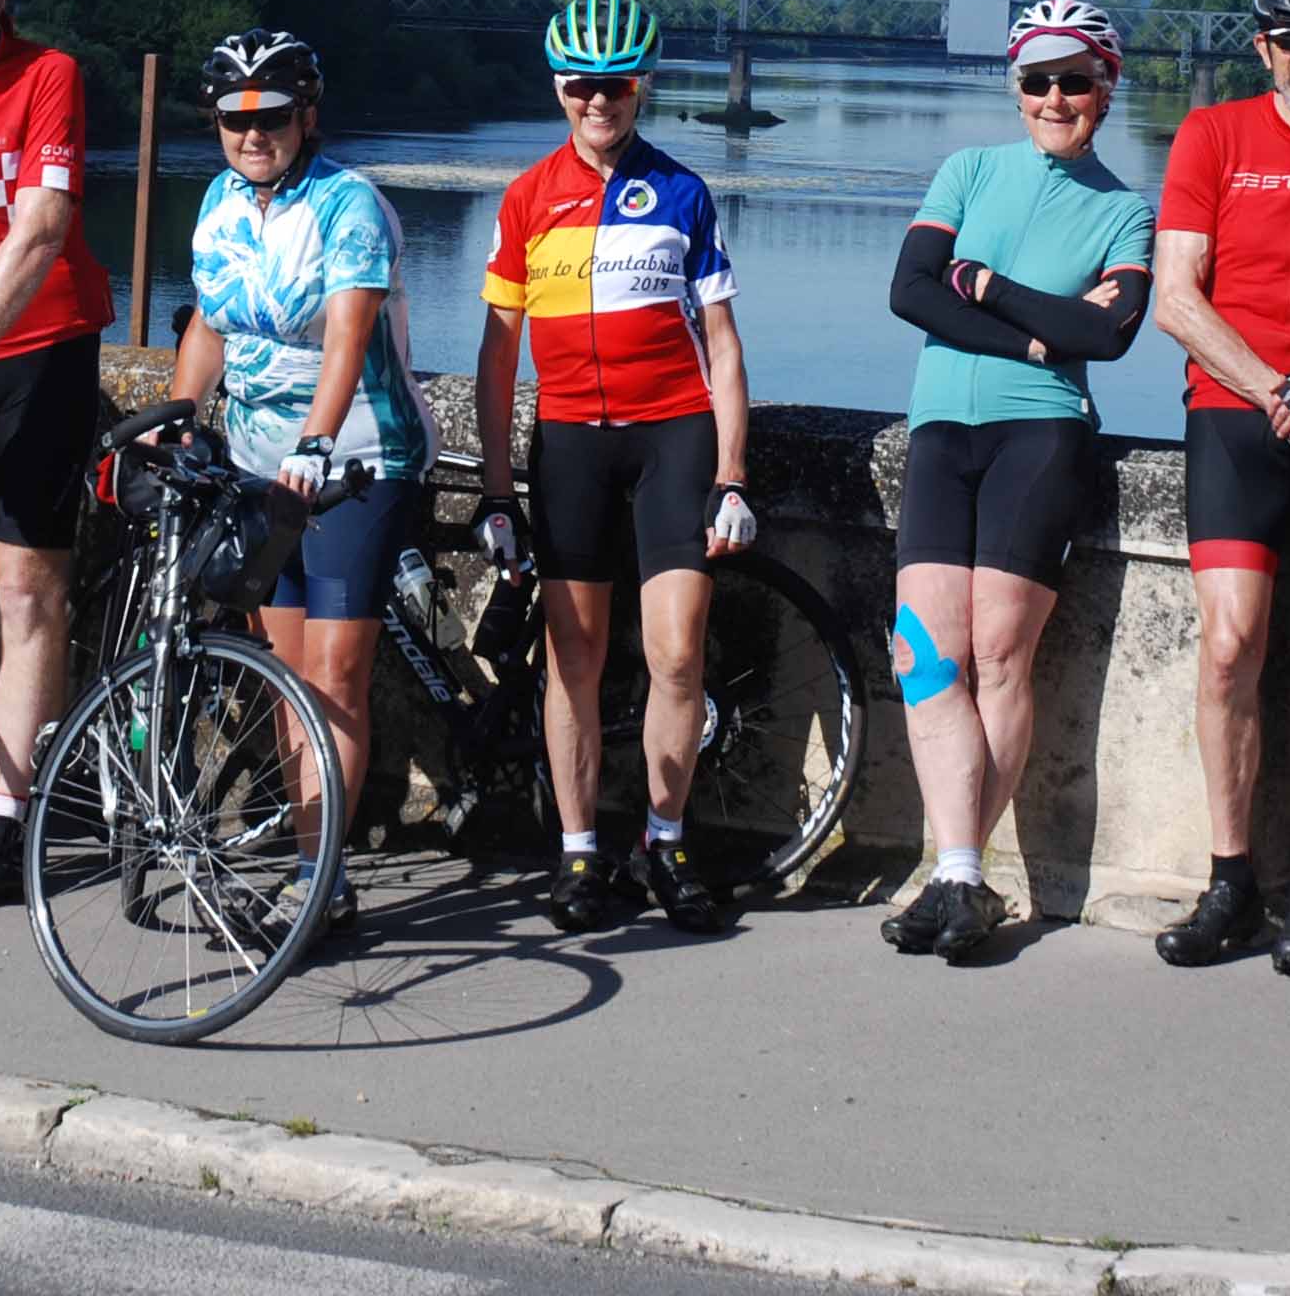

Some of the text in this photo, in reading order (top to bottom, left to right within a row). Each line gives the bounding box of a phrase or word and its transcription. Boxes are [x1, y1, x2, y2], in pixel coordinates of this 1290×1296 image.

[553, 259, 572, 277] to
[577, 255, 680, 280] Cantabria
[629, 275, 669, 292] 2019
